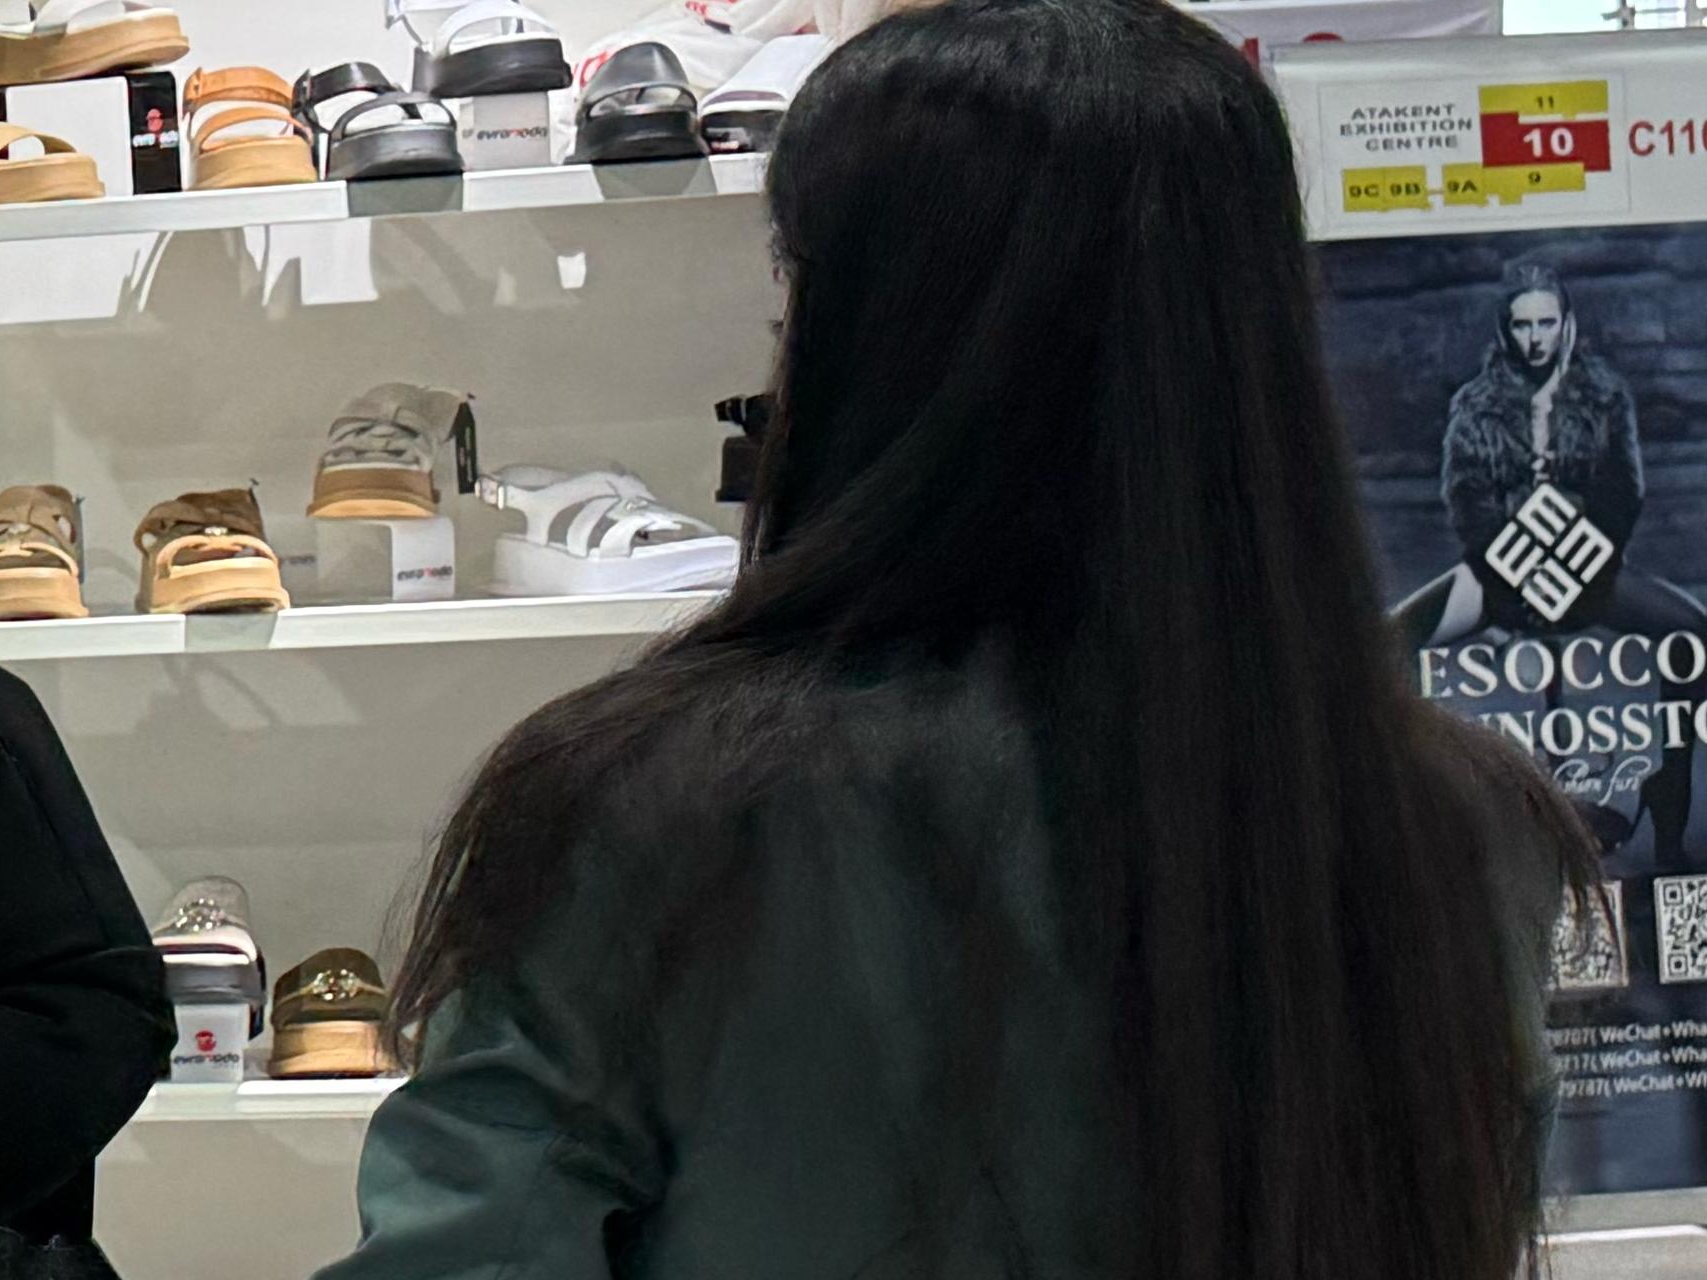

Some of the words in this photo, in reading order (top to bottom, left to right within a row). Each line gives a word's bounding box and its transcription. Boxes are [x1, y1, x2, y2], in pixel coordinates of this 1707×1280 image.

[1536, 95, 1555, 109] 11
[1351, 103, 1456, 120] ATAKENT
[1340, 118, 1473, 137] EXHIBITION
[1365, 135, 1459, 151] CENTRE
[1523, 127, 1575, 158] 10
[1629, 118, 1707, 157] C11
[1528, 171, 1542, 186] 9
[1349, 182, 1380, 199] 9C
[1389, 181, 1421, 196] 9B
[1446, 179, 1478, 194] 9A
